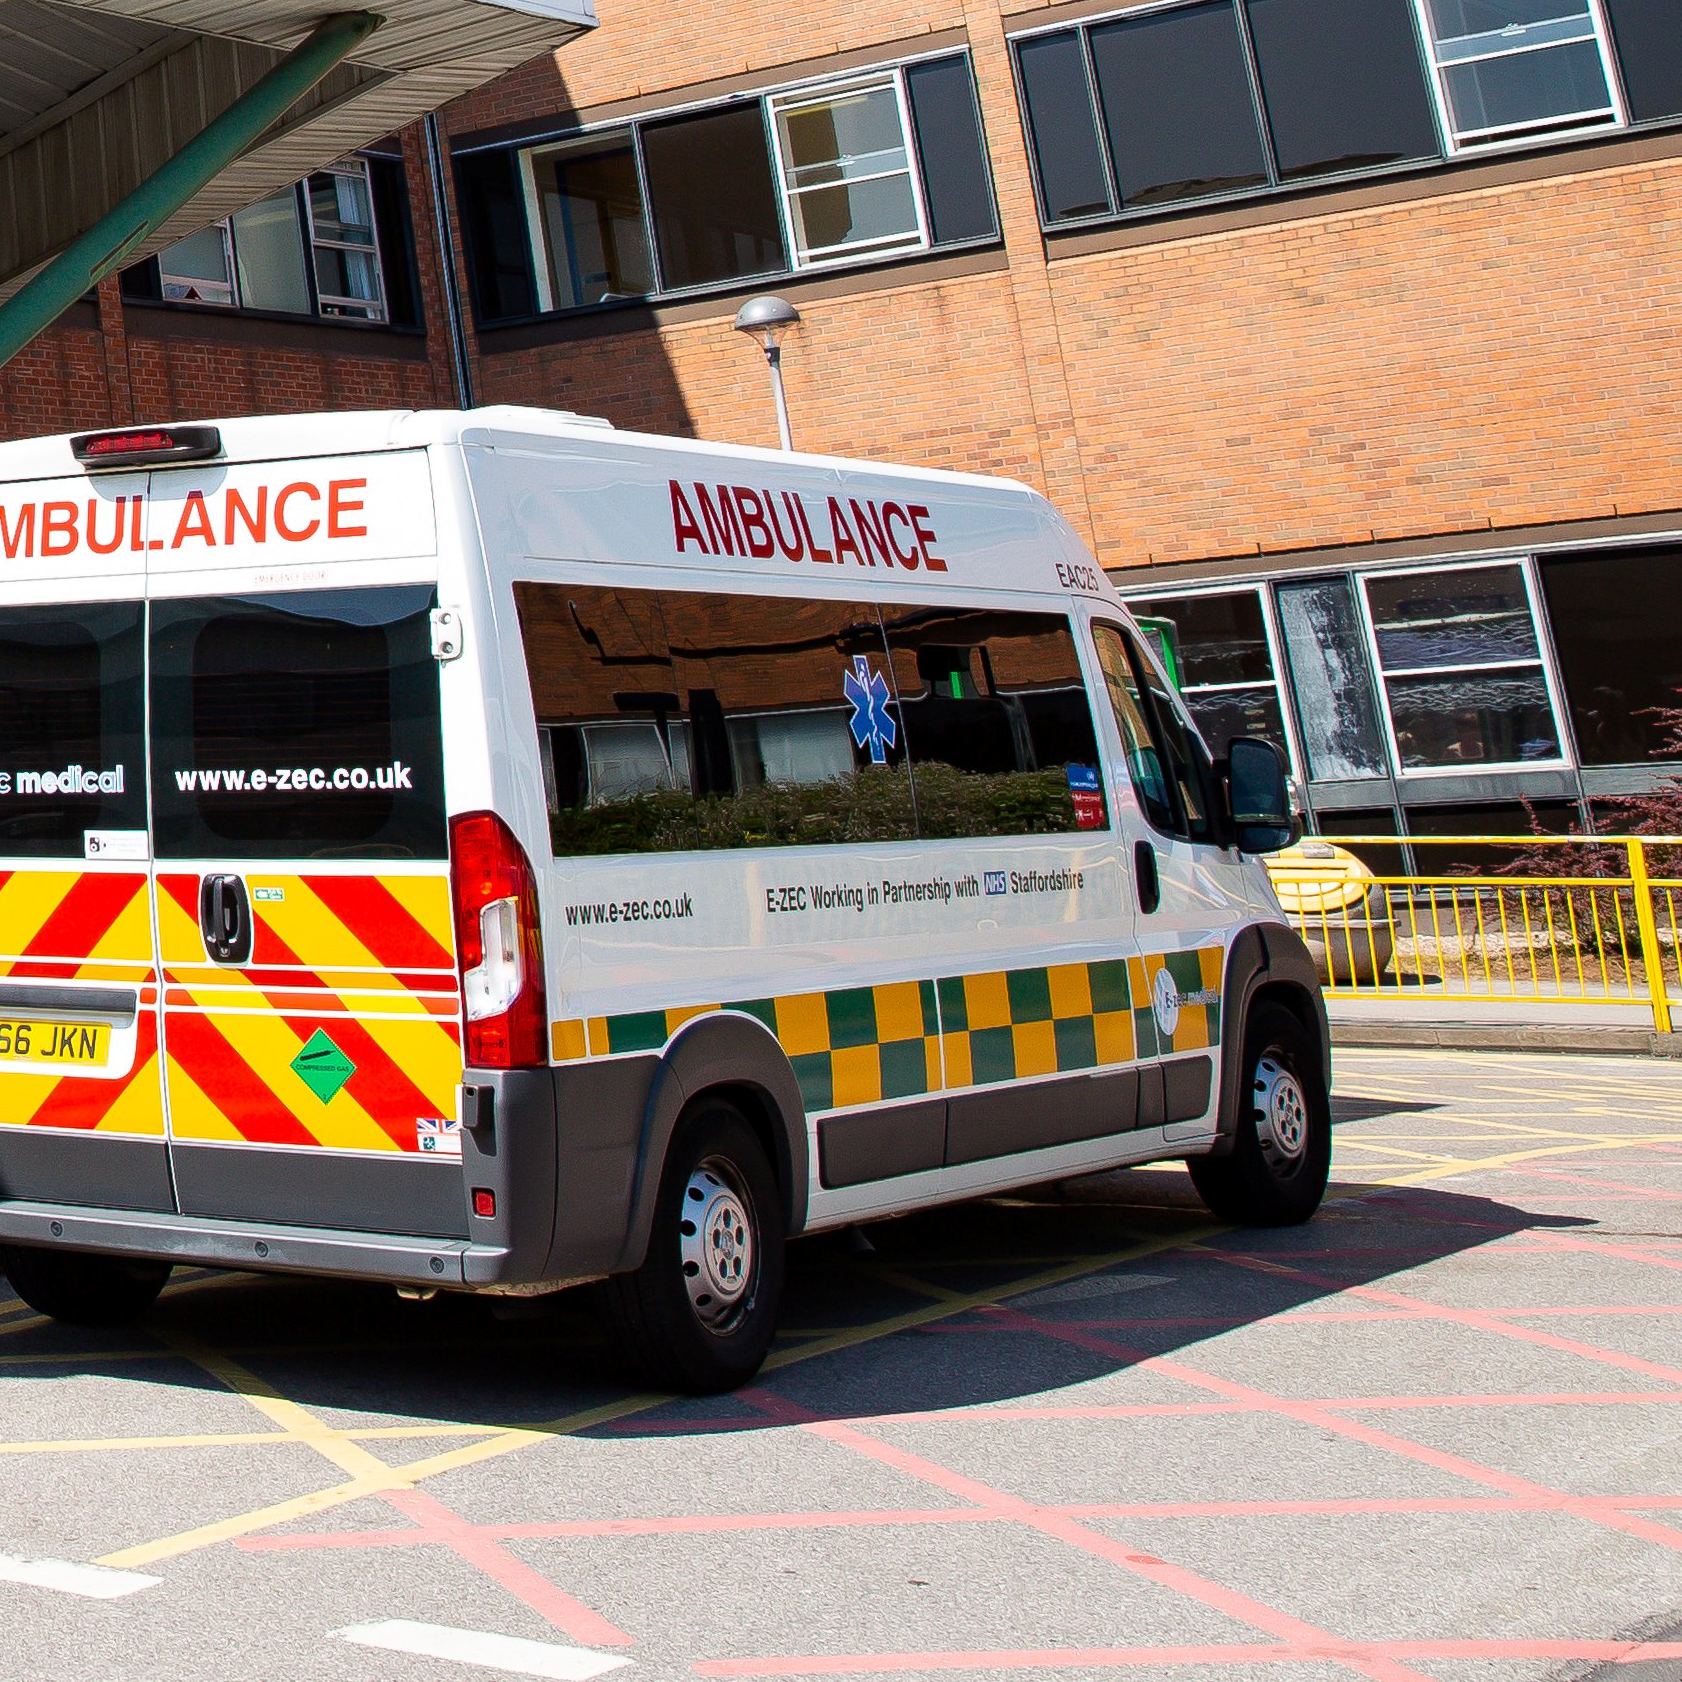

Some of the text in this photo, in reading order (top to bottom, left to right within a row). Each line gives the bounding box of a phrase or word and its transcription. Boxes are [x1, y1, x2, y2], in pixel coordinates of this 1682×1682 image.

[668, 479, 948, 572] AMBULANCE
[1054, 562, 1100, 592] EAC25
[16, 764, 125, 794] medical
[175, 761, 412, 793] www.e-zec.co.uk
[766, 868, 1084, 913] E-ZEC Working in Partnership with NHS Staffordshire
[565, 892, 694, 926] www.e-zec.co.uk
[40, 1026, 98, 1059] JKN
[295, 1064, 337, 1072] COMPRESSED
